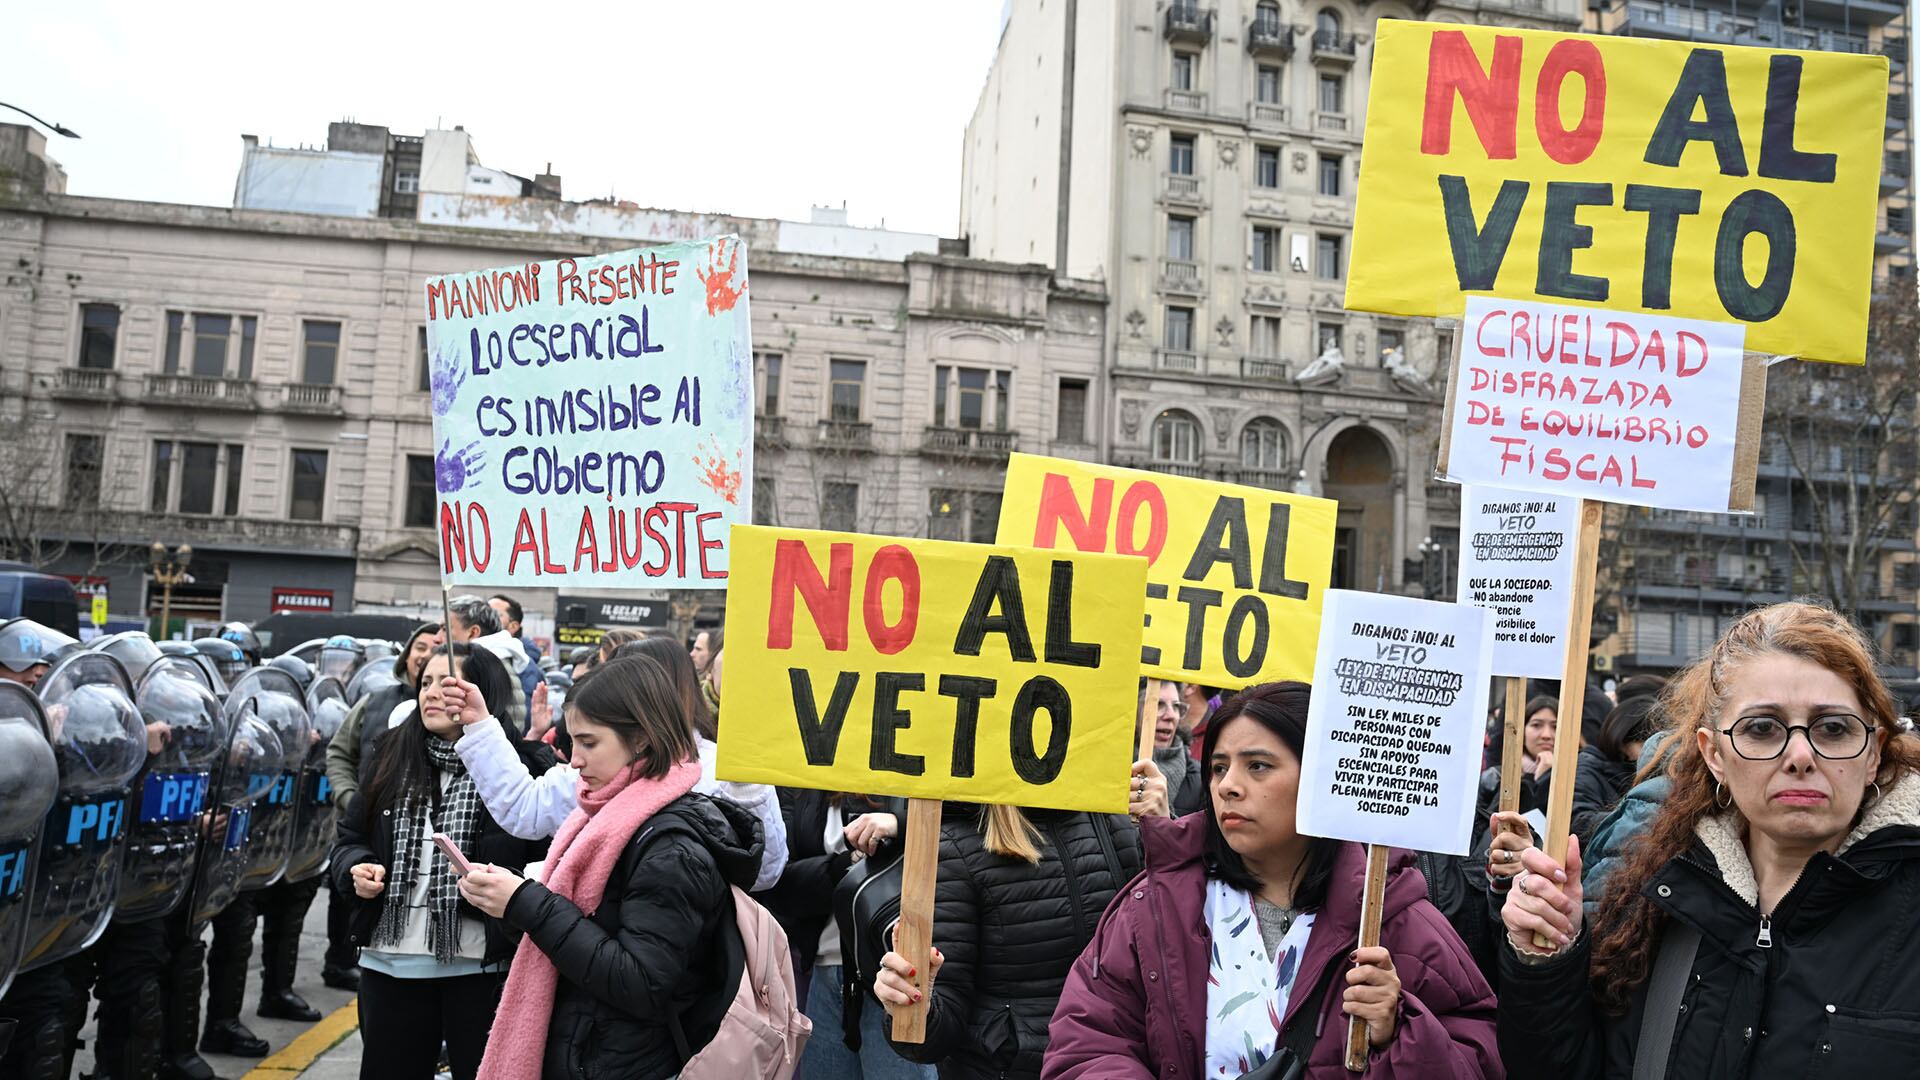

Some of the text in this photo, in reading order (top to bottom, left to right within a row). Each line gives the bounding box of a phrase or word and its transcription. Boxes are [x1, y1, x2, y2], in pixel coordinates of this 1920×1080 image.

[1421, 30, 1838, 183] NO AL
[1438, 174, 1797, 322] VETO
[557, 252, 680, 305] PRESENTE
[1476, 310, 1709, 378] CRUELDAD
[1467, 400, 1505, 427] DE
[1545, 502, 1556, 513] AL
[1499, 515, 1536, 531] VETO
[440, 500, 491, 575] NO
[509, 506, 567, 576] AL
[1033, 473, 1310, 601] NO AL
[1505, 533, 1563, 548] EMERGENCIA
[1476, 547, 1488, 560] EN
[1469, 578, 1552, 590] QUE LA SOCIEDAD:
[767, 539, 1101, 669] NO AL
[1488, 591, 1533, 603] abandone
[1141, 583, 1269, 678] ETO
[1411, 630, 1438, 646] ¡NO!
[1440, 634, 1455, 648] AL
[1518, 632, 1528, 643] el
[1530, 632, 1556, 644] dolor
[1376, 641, 1427, 665] VETO
[1341, 677, 1360, 693] EN
[1381, 665, 1461, 691] EMERGENCIA
[789, 667, 1072, 785] VETO
[1347, 705, 1366, 717] SIN
[1391, 711, 1425, 725] MILES
[1427, 716, 1441, 728] DE
[1354, 719, 1432, 740] PERSONAS CON
[1330, 730, 1451, 756] DICAPACIDAD QUEDAN
[1359, 746, 1420, 765] SIN APOYOS
[1338, 757, 1438, 780] ESCENCIALES PARA
[1335, 770, 1439, 794] VIVIR Y PARTICIPAR
[160, 780, 205, 815] PFA
[1331, 784, 1438, 807] PLENAMENTE EN LA
[1357, 800, 1410, 816] SOCIEDAD
[0, 848, 28, 896] FA
